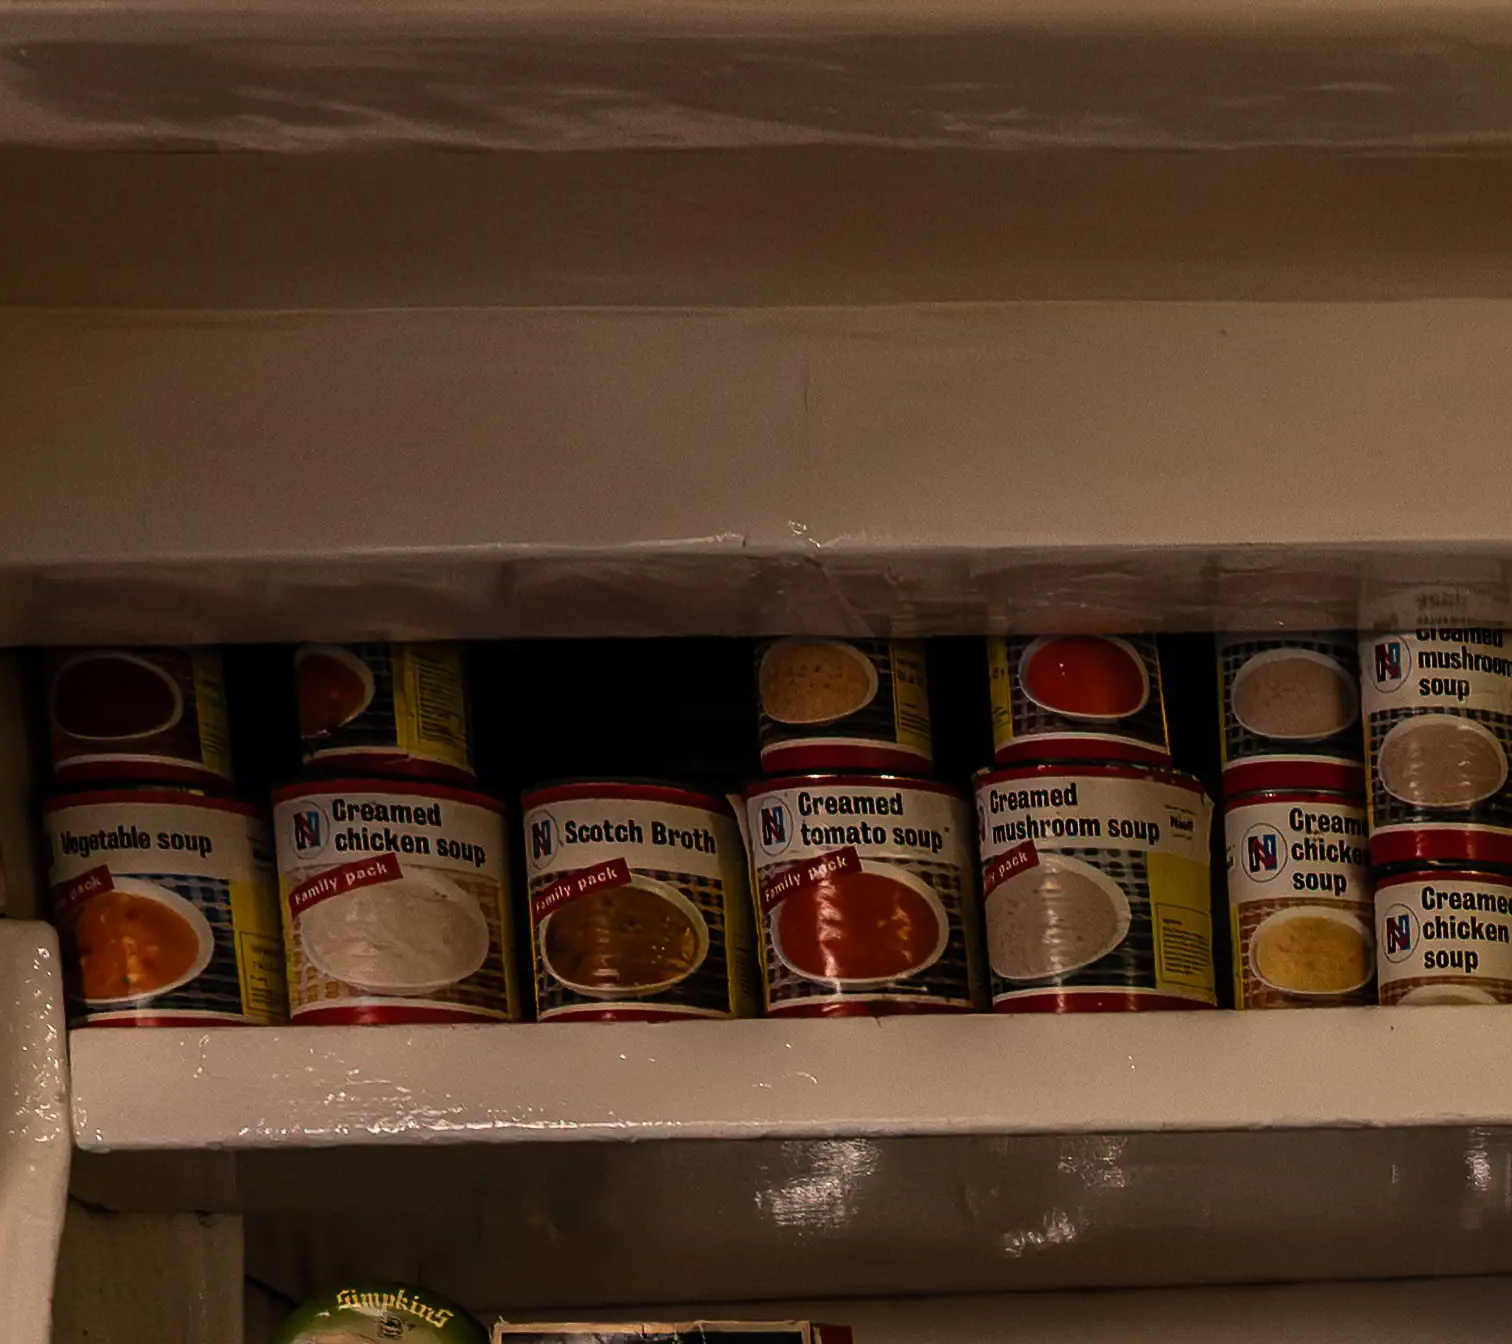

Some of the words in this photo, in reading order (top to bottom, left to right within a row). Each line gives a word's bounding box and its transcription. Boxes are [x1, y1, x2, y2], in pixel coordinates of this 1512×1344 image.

[333, 800, 443, 828] Creamed
[335, 827, 431, 857] chicken
[436, 833, 486, 868] soup
[565, 820, 643, 850] Scotch
[650, 821, 717, 854] Broth
